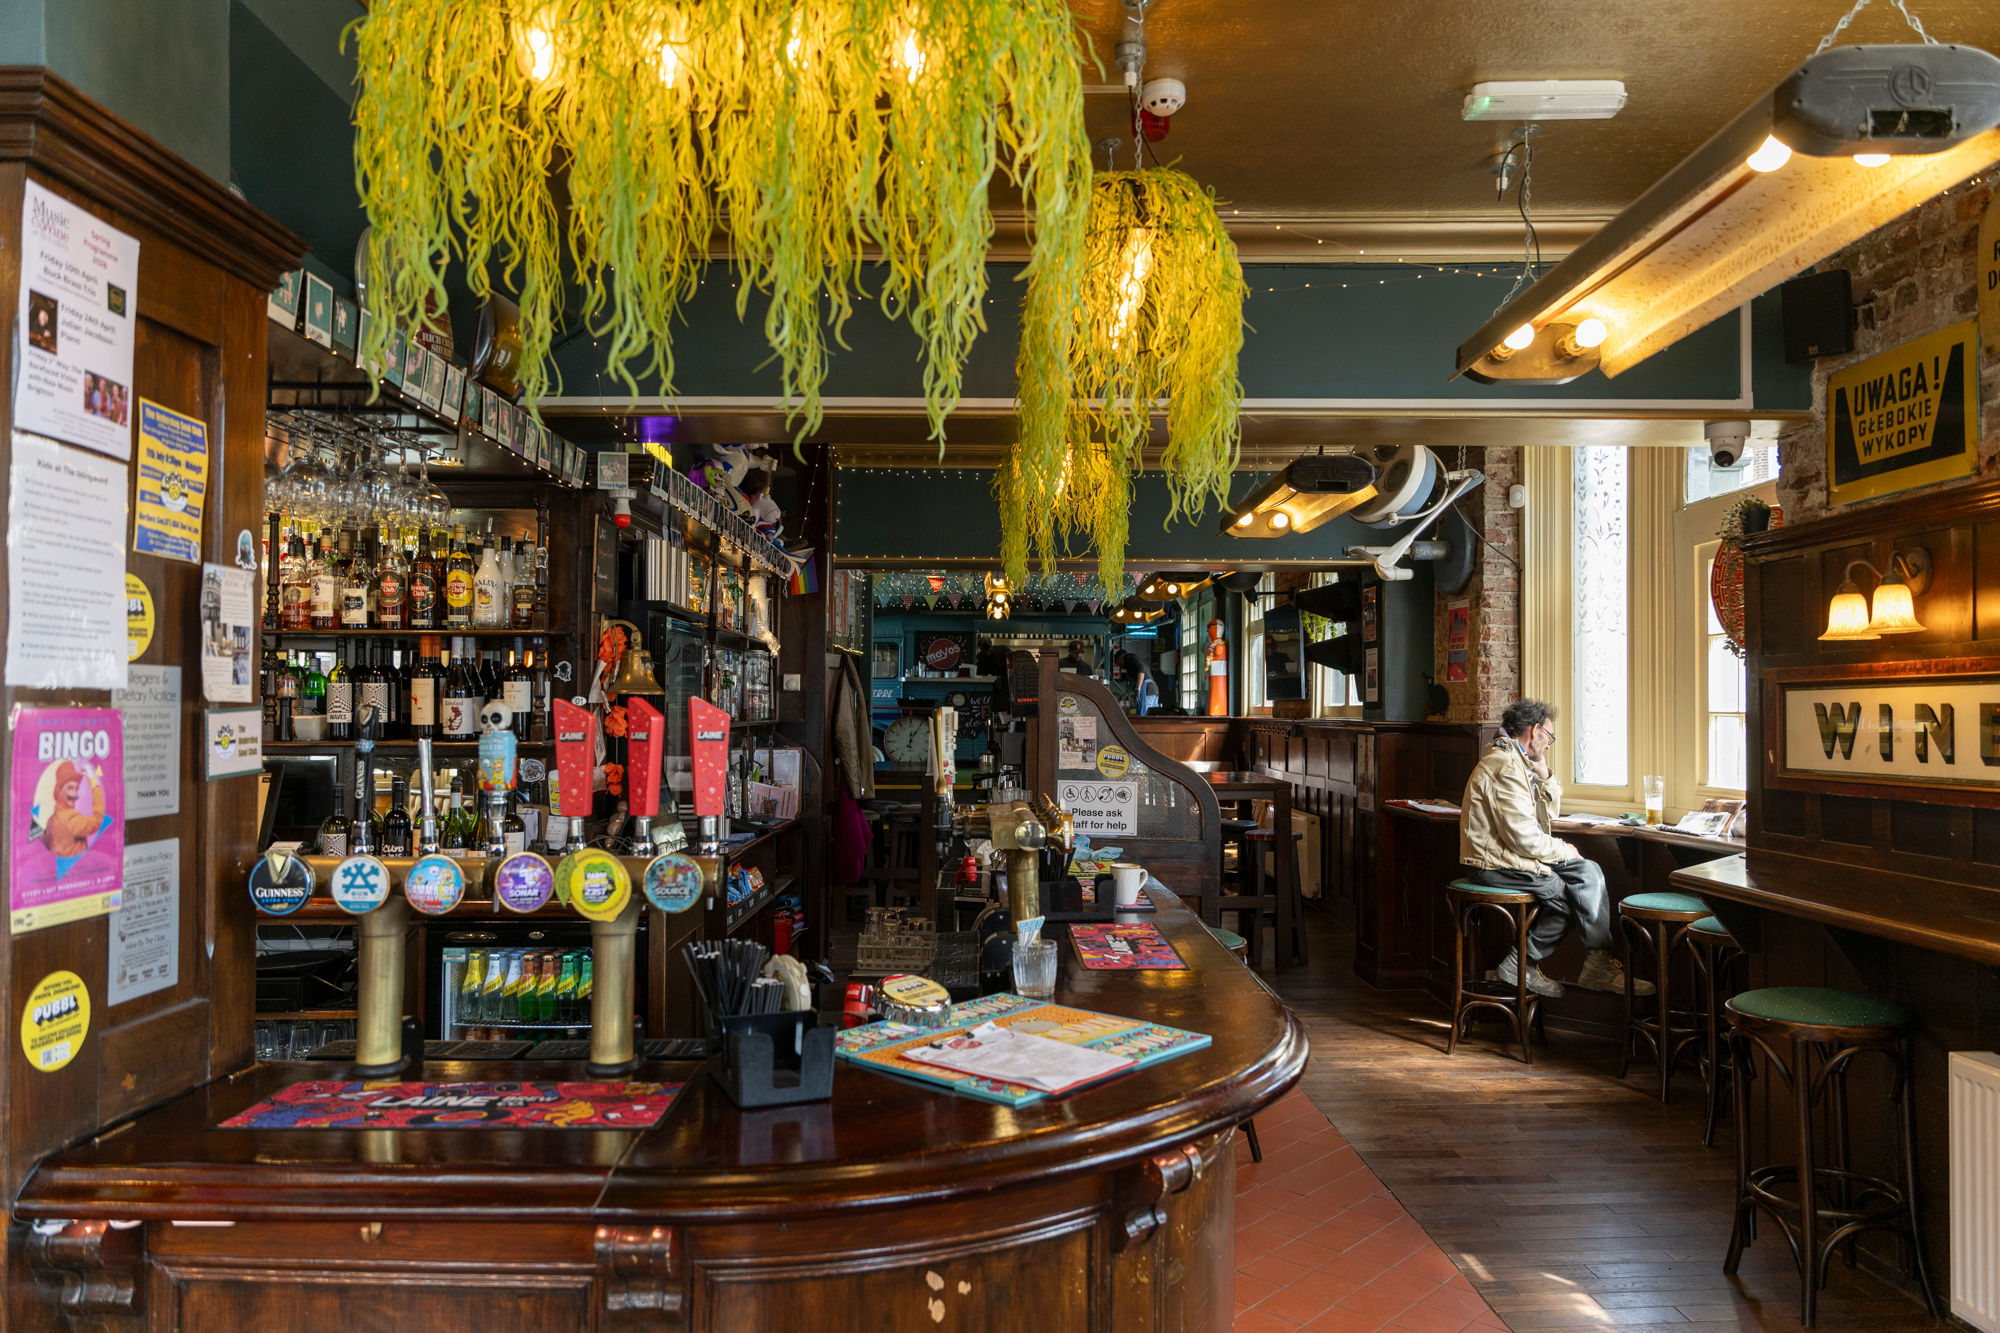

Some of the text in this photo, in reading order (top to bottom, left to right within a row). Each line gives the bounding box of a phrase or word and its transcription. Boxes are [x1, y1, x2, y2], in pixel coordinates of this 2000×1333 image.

[91, 229, 111, 249] Spring
[84, 238, 118, 262] Programme
[40, 250, 63, 269] Friday
[82, 270, 99, 285] April
[61, 303, 82, 321] Friday
[101, 320, 116, 334] April
[61, 331, 81, 345] Piano
[422, 332, 441, 345] RICH
[1853, 356, 1942, 417] UWAGA!
[1858, 398, 1932, 438] GŁĘBOKIE
[1862, 422, 1928, 458] WYKOPY
[63, 466, 75, 476] The
[474, 579, 499, 590] MALIBU
[926, 644, 960, 663] mayos
[116, 688, 177, 704] Dietary Notice
[78, 717, 110, 726] PARTY
[559, 732, 586, 742] LAINE
[630, 731, 649, 741] LAINE
[697, 731, 725, 742] LAINE
[1813, 702, 2000, 766] WINE
[37, 729, 110, 761] BINGO
[1104, 752, 1125, 762] PUBBL
[355, 760, 366, 799] GUINNESS
[137, 788, 170, 799] THANK YOU
[1072, 808, 1123, 818] Please ask
[1072, 820, 1127, 832] taff for help
[255, 887, 304, 898] GUINNESS
[509, 888, 540, 898] SONAR
[33, 994, 79, 1026] PUBBL
[367, 1095, 500, 1108] LAINE
